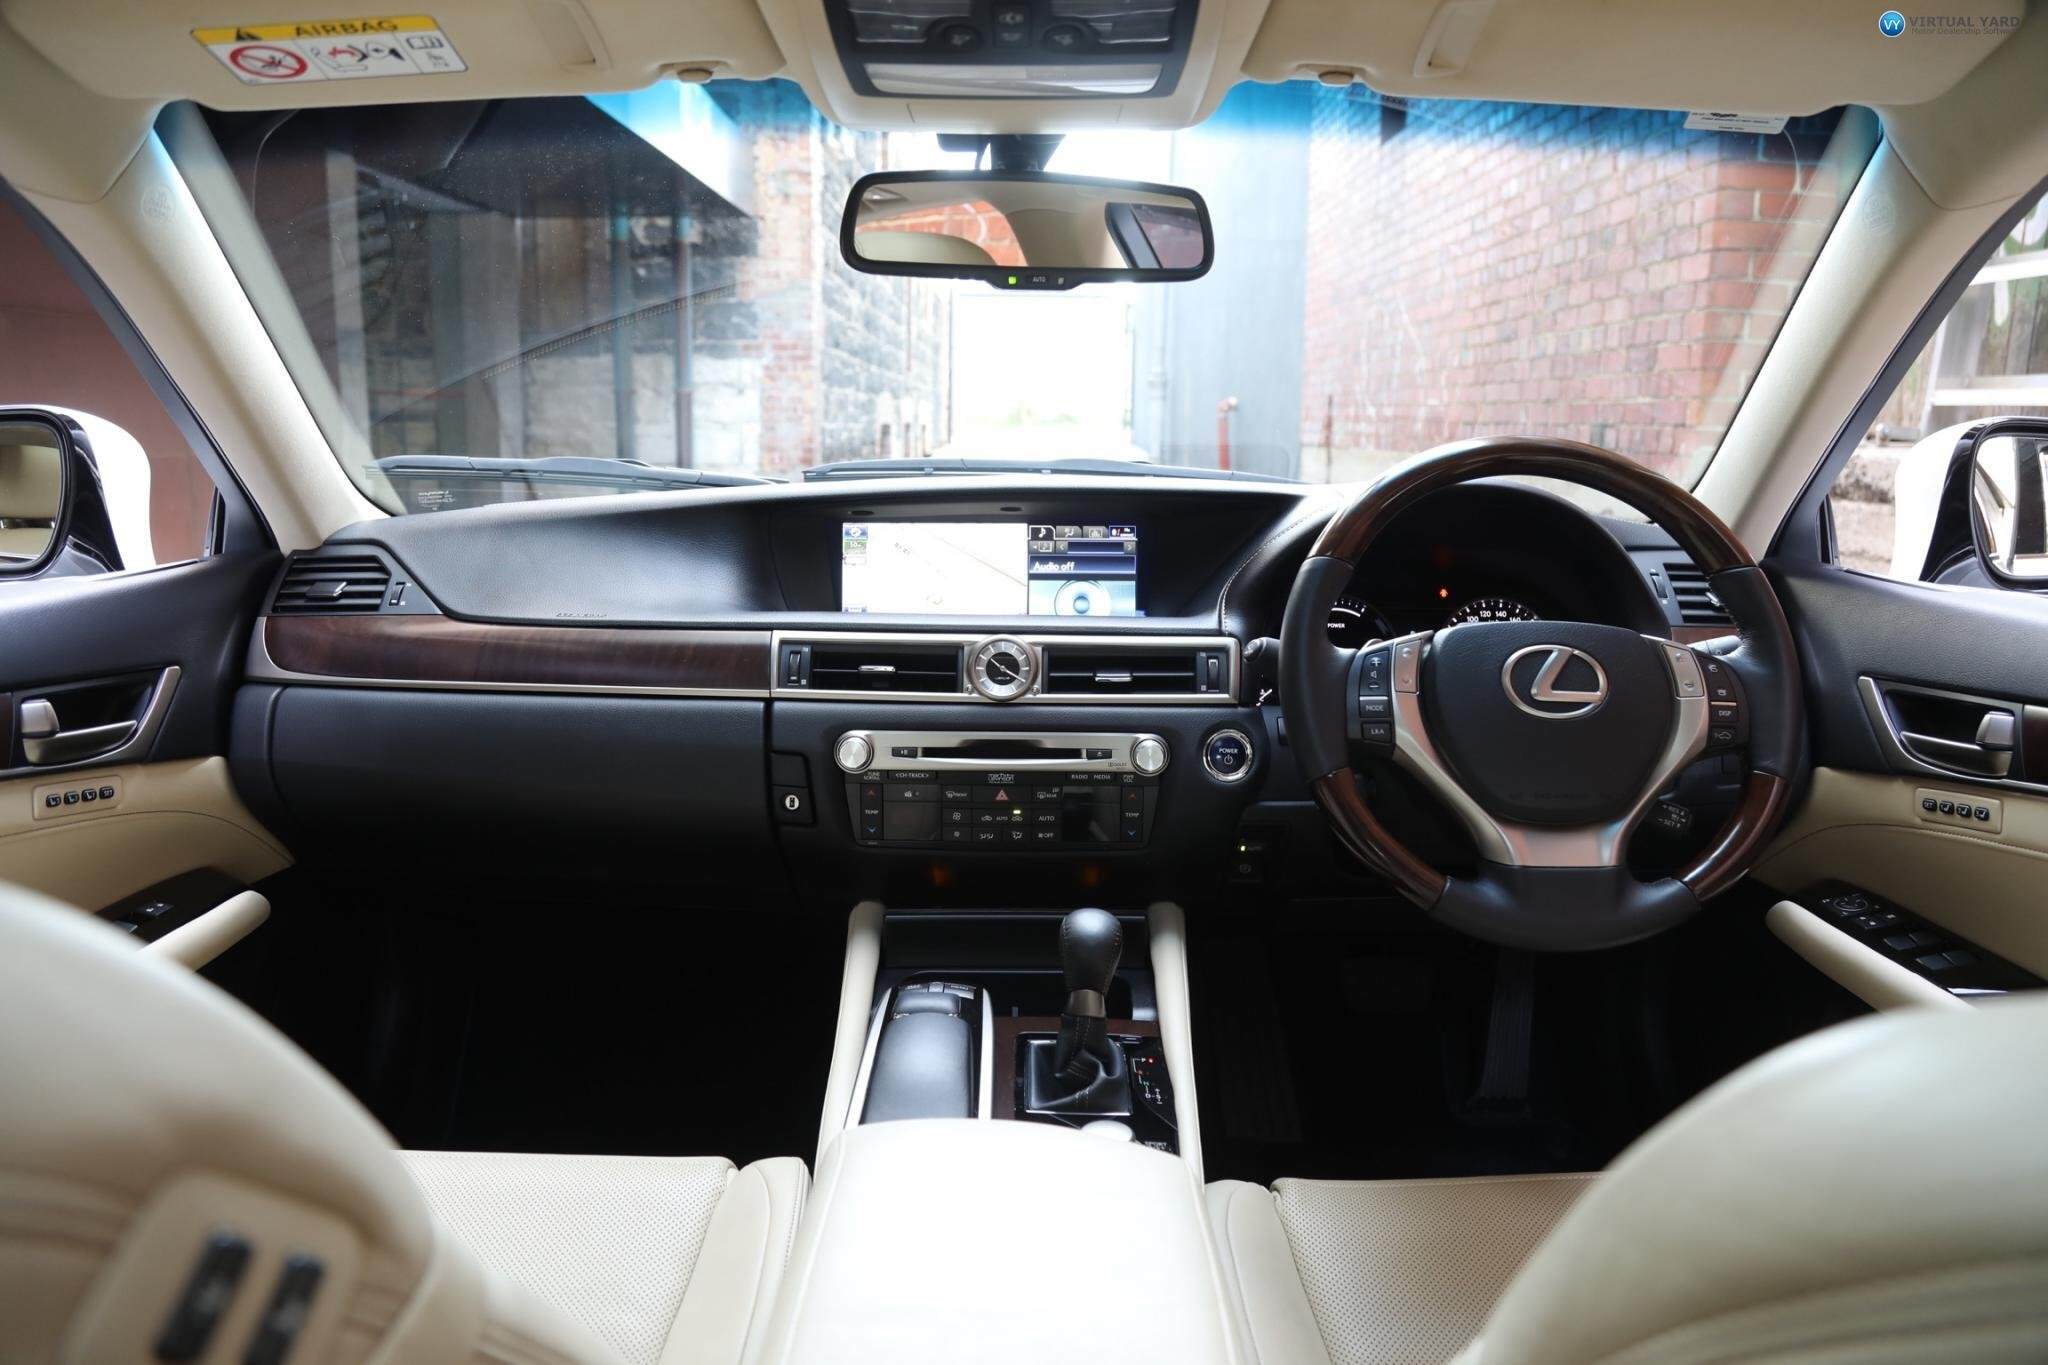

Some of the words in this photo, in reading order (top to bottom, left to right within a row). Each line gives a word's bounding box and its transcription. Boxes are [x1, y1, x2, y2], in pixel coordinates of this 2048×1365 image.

[295, 19, 399, 38] AIRBAG
[1033, 562, 1060, 571] Audio
[1061, 561, 1075, 571] off
